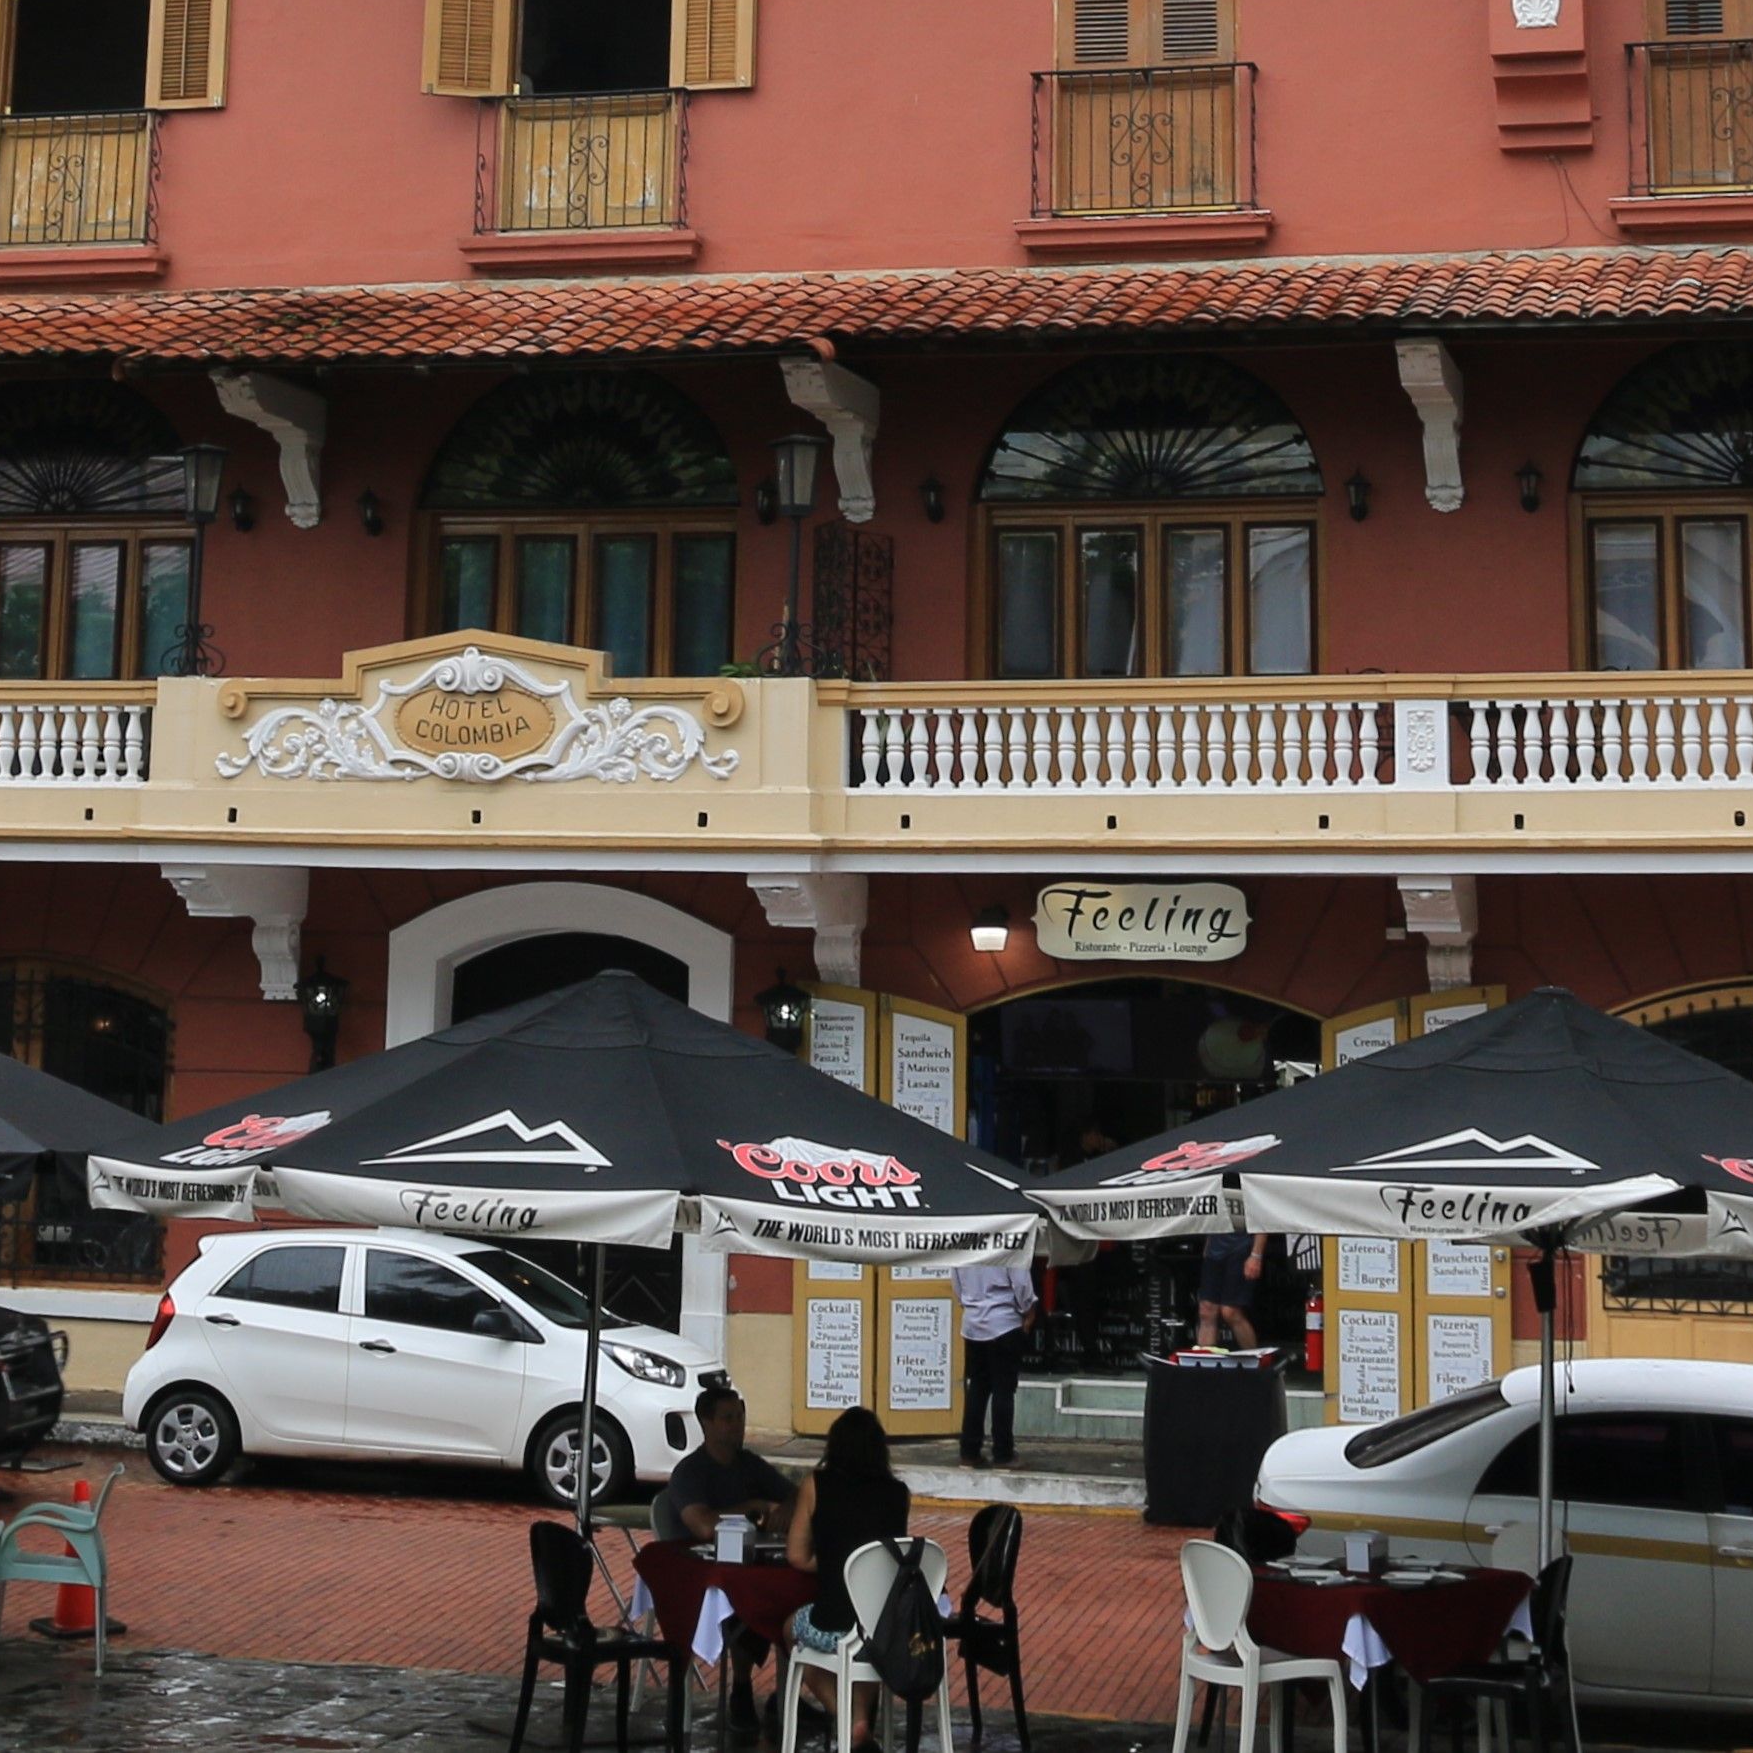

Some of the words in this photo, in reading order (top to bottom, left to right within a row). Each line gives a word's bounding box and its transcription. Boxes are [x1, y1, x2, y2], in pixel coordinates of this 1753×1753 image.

[429, 695, 511, 720] HOTEL
[415, 716, 531, 745] COLOMBIA
[1042, 888, 1241, 943] Feeling
[1074, 941, 1122, 953] Ristorante
[1129, 941, 1166, 953] Pizzeria
[1173, 942, 1208, 956] Lounge
[1353, 1036, 1392, 1047] Cremas
[897, 1048, 952, 1059] Sandwich
[907, 1062, 950, 1073] Mariscos
[907, 1079, 940, 1088] Lasaña
[716, 1138, 922, 1186] Coors
[770, 1179, 923, 1209] LIGHT
[399, 1189, 544, 1230] Feeling
[1109, 1199, 1134, 1221] MOST
[752, 1218, 782, 1238] THE
[787, 1222, 854, 1246] WORLD'S
[858, 1230, 901, 1249] MOST
[905, 1232, 992, 1252] REFRESHING
[1432, 1253, 1489, 1264] Bruschetta
[1361, 1273, 1396, 1288] Burger
[811, 1301, 851, 1313] Cocktail
[1342, 1314, 1386, 1326] Cocktail
[897, 1355, 926, 1365] Filete
[906, 1367, 945, 1377] Postres
[1436, 1372, 1467, 1384] Filete
[826, 1391, 857, 1406] Burger
[892, 1385, 945, 1397] Champagne
[1360, 1406, 1396, 1421] Burger
